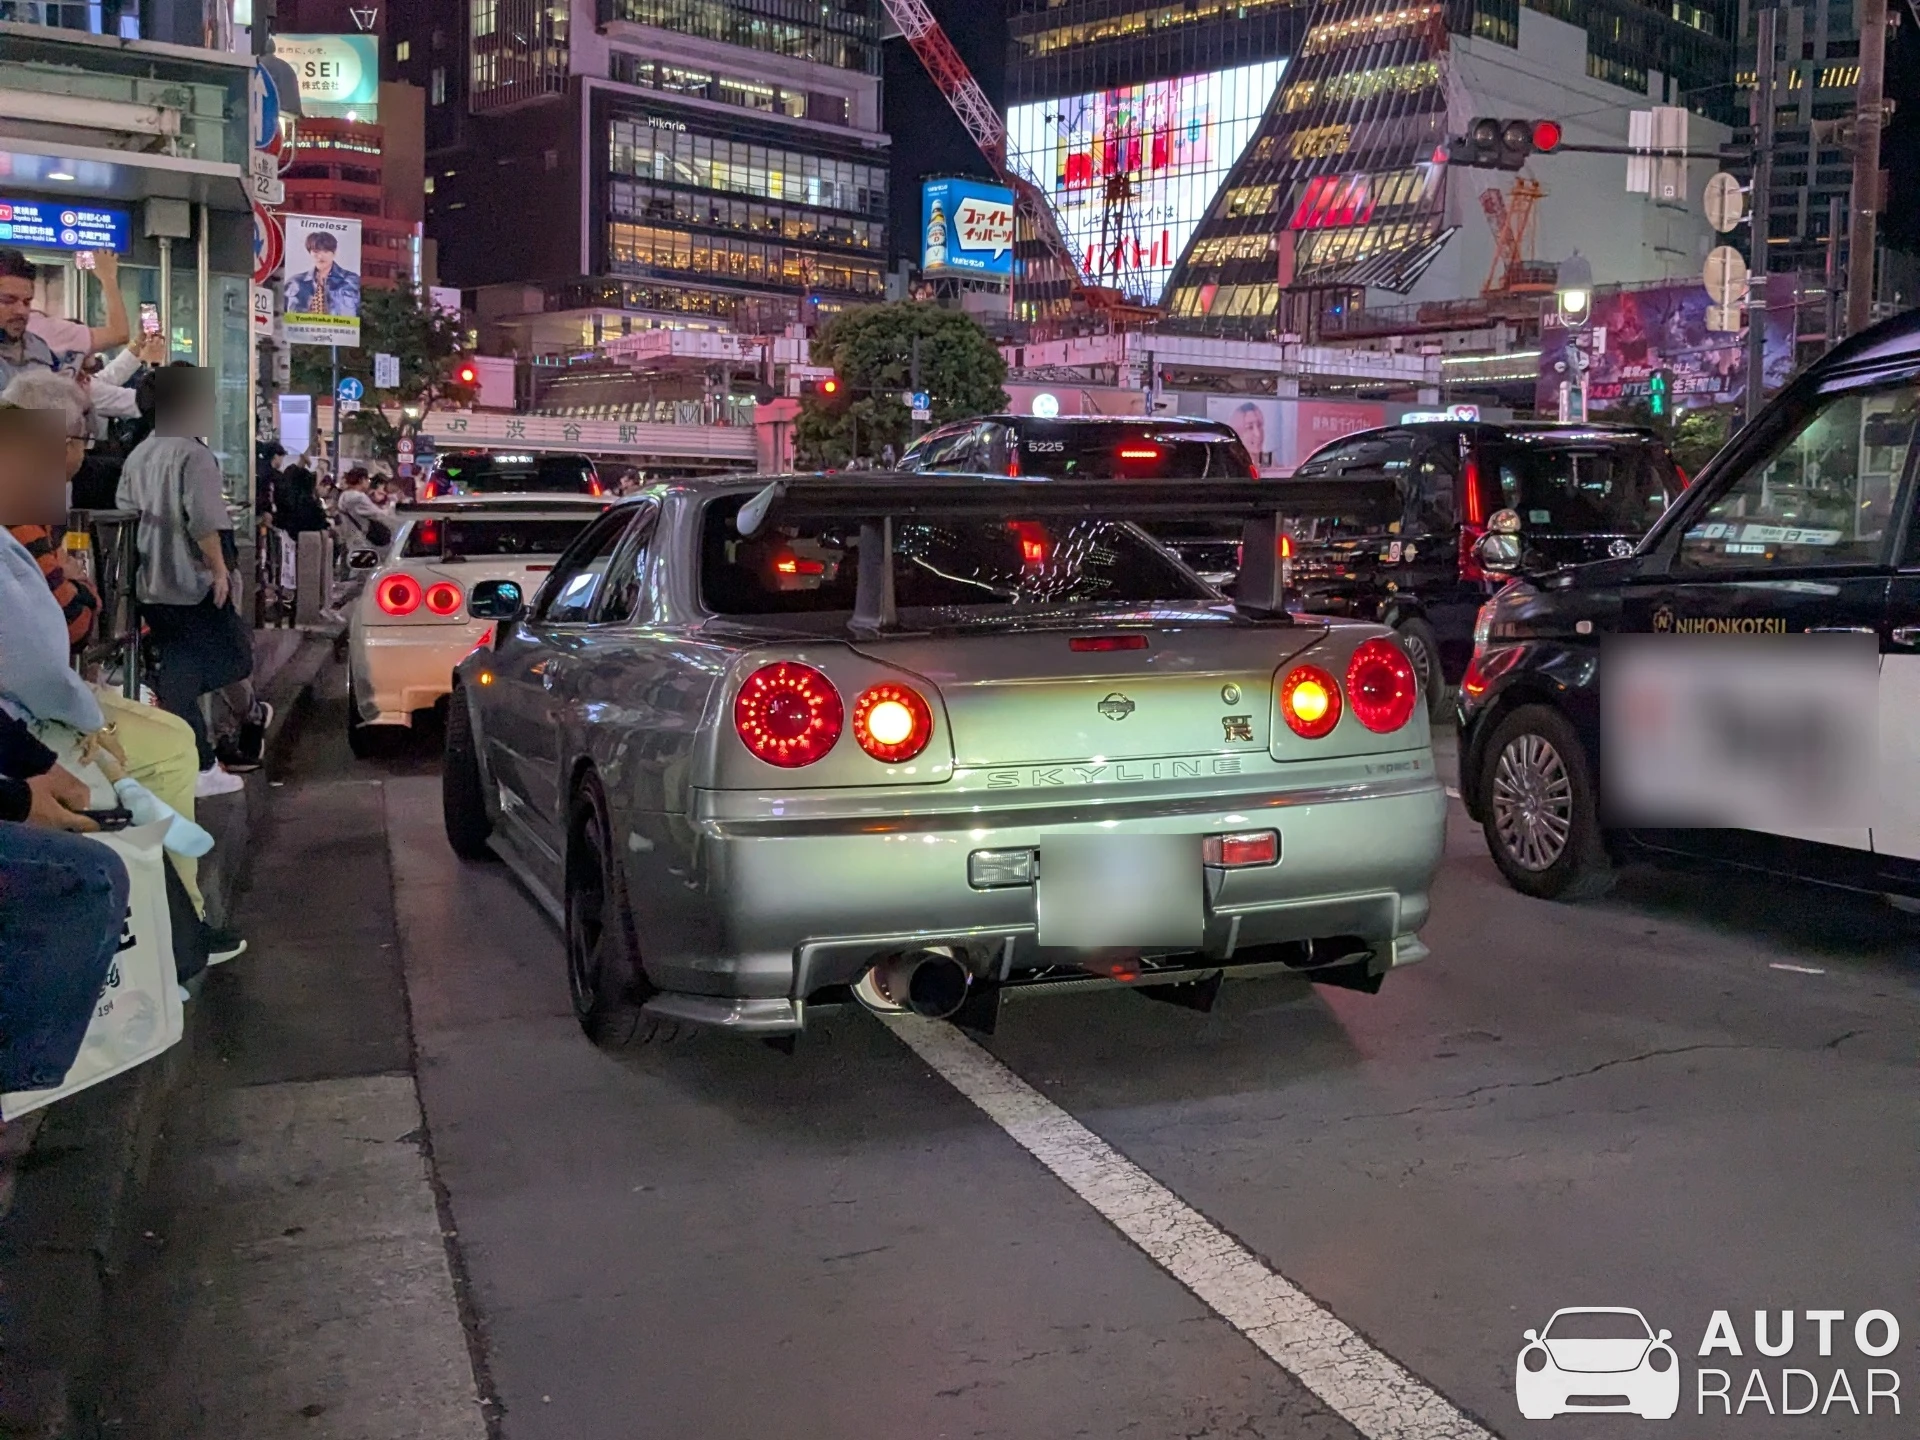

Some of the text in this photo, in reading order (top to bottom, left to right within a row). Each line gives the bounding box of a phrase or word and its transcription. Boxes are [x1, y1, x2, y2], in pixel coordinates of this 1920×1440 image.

[302, 80, 340, 91] 株式会社
[648, 115, 686, 132] Hikarie
[257, 177, 270, 195] 22
[78, 212, 111, 224] 副都心線
[963, 207, 1012, 227] ファイト
[13, 224, 54, 237] 田園都市線
[300, 219, 348, 231] timelesz
[963, 227, 1013, 243] イッパーツ
[254, 293, 268, 310] 20
[333, 317, 351, 325] Hara
[446, 418, 468, 433] JR
[1028, 442, 1064, 453] 5225
[517, 455, 534, 463] TAXI
[1676, 618, 1786, 634] NIHONKOTSU
[987, 757, 1242, 789] SKYLINE
